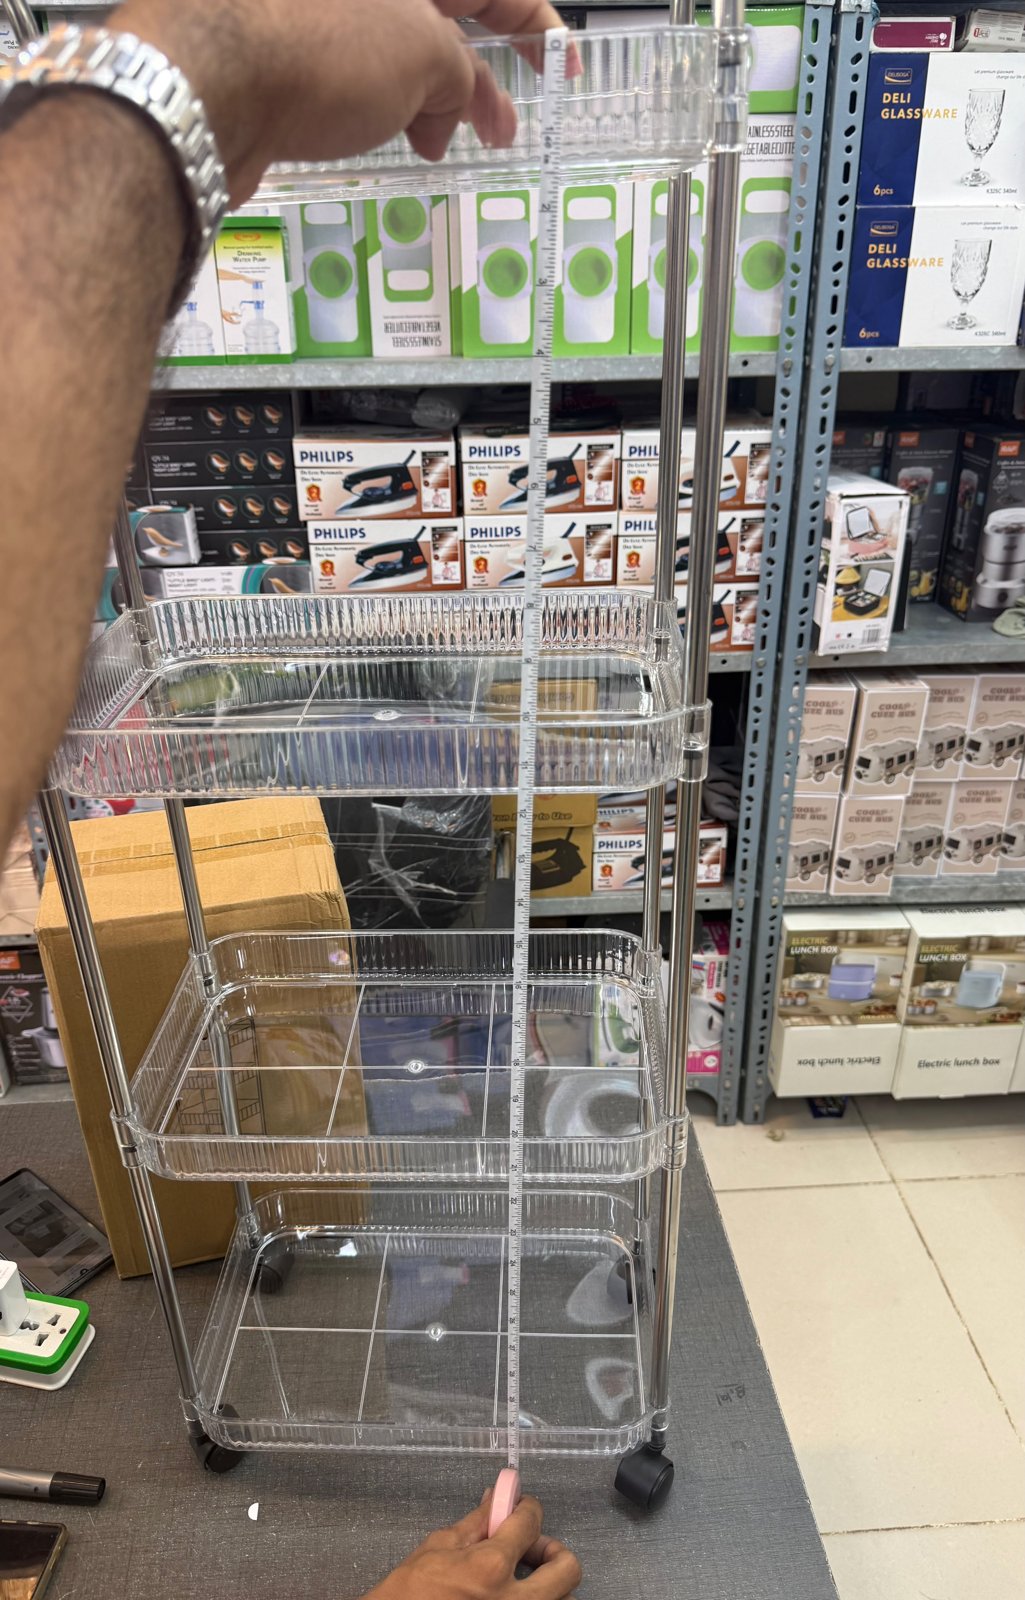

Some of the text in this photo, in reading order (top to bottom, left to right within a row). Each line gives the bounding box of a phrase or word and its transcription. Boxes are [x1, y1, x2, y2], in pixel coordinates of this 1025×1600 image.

[551, 40, 561, 49] 0
[883, 93, 911, 104] DELI
[881, 108, 958, 119] GLASSWARE
[873, 185, 893, 196] 6pcs
[541, 203, 551, 211] 2
[868, 243, 897, 254] DELI
[866, 257, 944, 269] GLASSWARE
[859, 328, 880, 339] 6pcs
[469, 445, 521, 457] PHILIPS
[629, 445, 659, 456] PHIL
[300, 450, 354, 462] PHILIPS
[625, 520, 656, 531] PHIL
[314, 528, 366, 539] PHILIPS
[470, 526, 521, 538] PHILIPS
[519, 809, 526, 818] 12
[598, 840, 642, 849] PHILIPS
[518, 854, 525, 863] 13
[517, 898, 524, 906] 14
[516, 940, 522, 948] 15
[791, 937, 828, 945] ELECTRIC
[790, 946, 819, 955] LUNCH
[919, 954, 947, 962] LUNCH
[515, 981, 522, 989] 16
[514, 1020, 520, 1028] 17
[798, 1056, 881, 1066] Electric lunch box
[917, 1058, 1000, 1069] Electric lunch box
